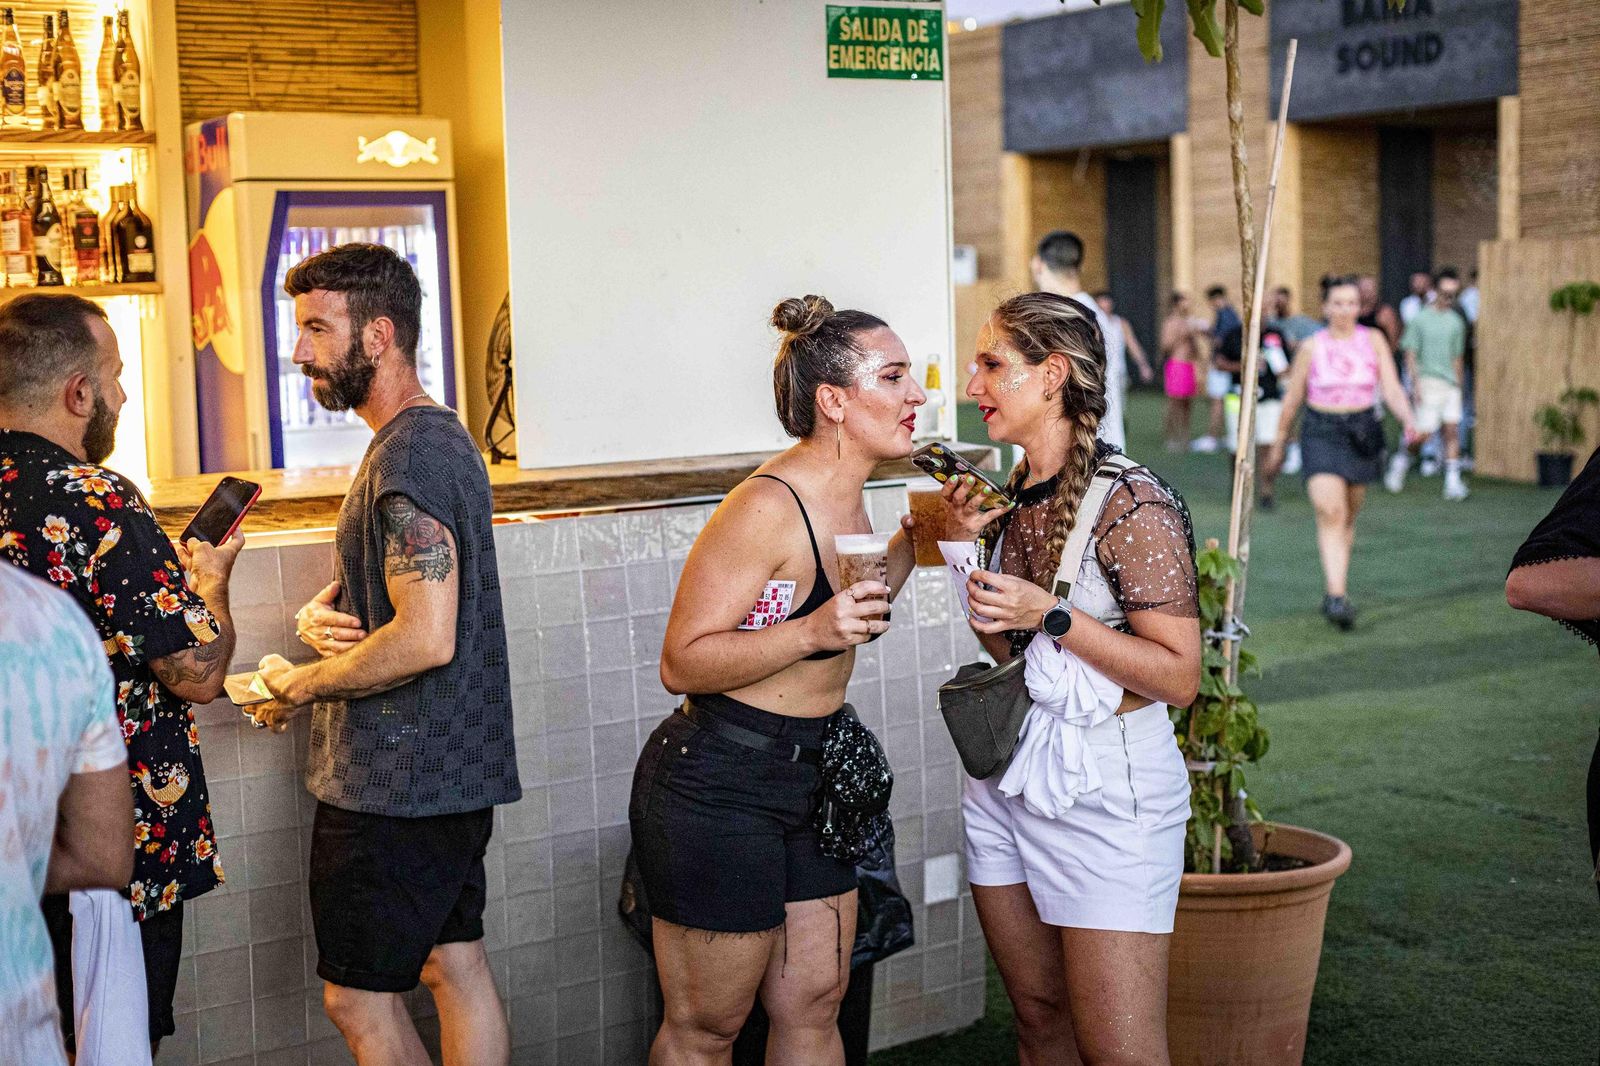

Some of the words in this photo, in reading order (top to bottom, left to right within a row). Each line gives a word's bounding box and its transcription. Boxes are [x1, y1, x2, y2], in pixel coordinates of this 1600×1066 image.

[840, 16, 903, 41] SALIDA
[907, 19, 929, 43] DE
[828, 45, 940, 71] EMERGENCIA
[1336, 31, 1444, 75] SOUND
